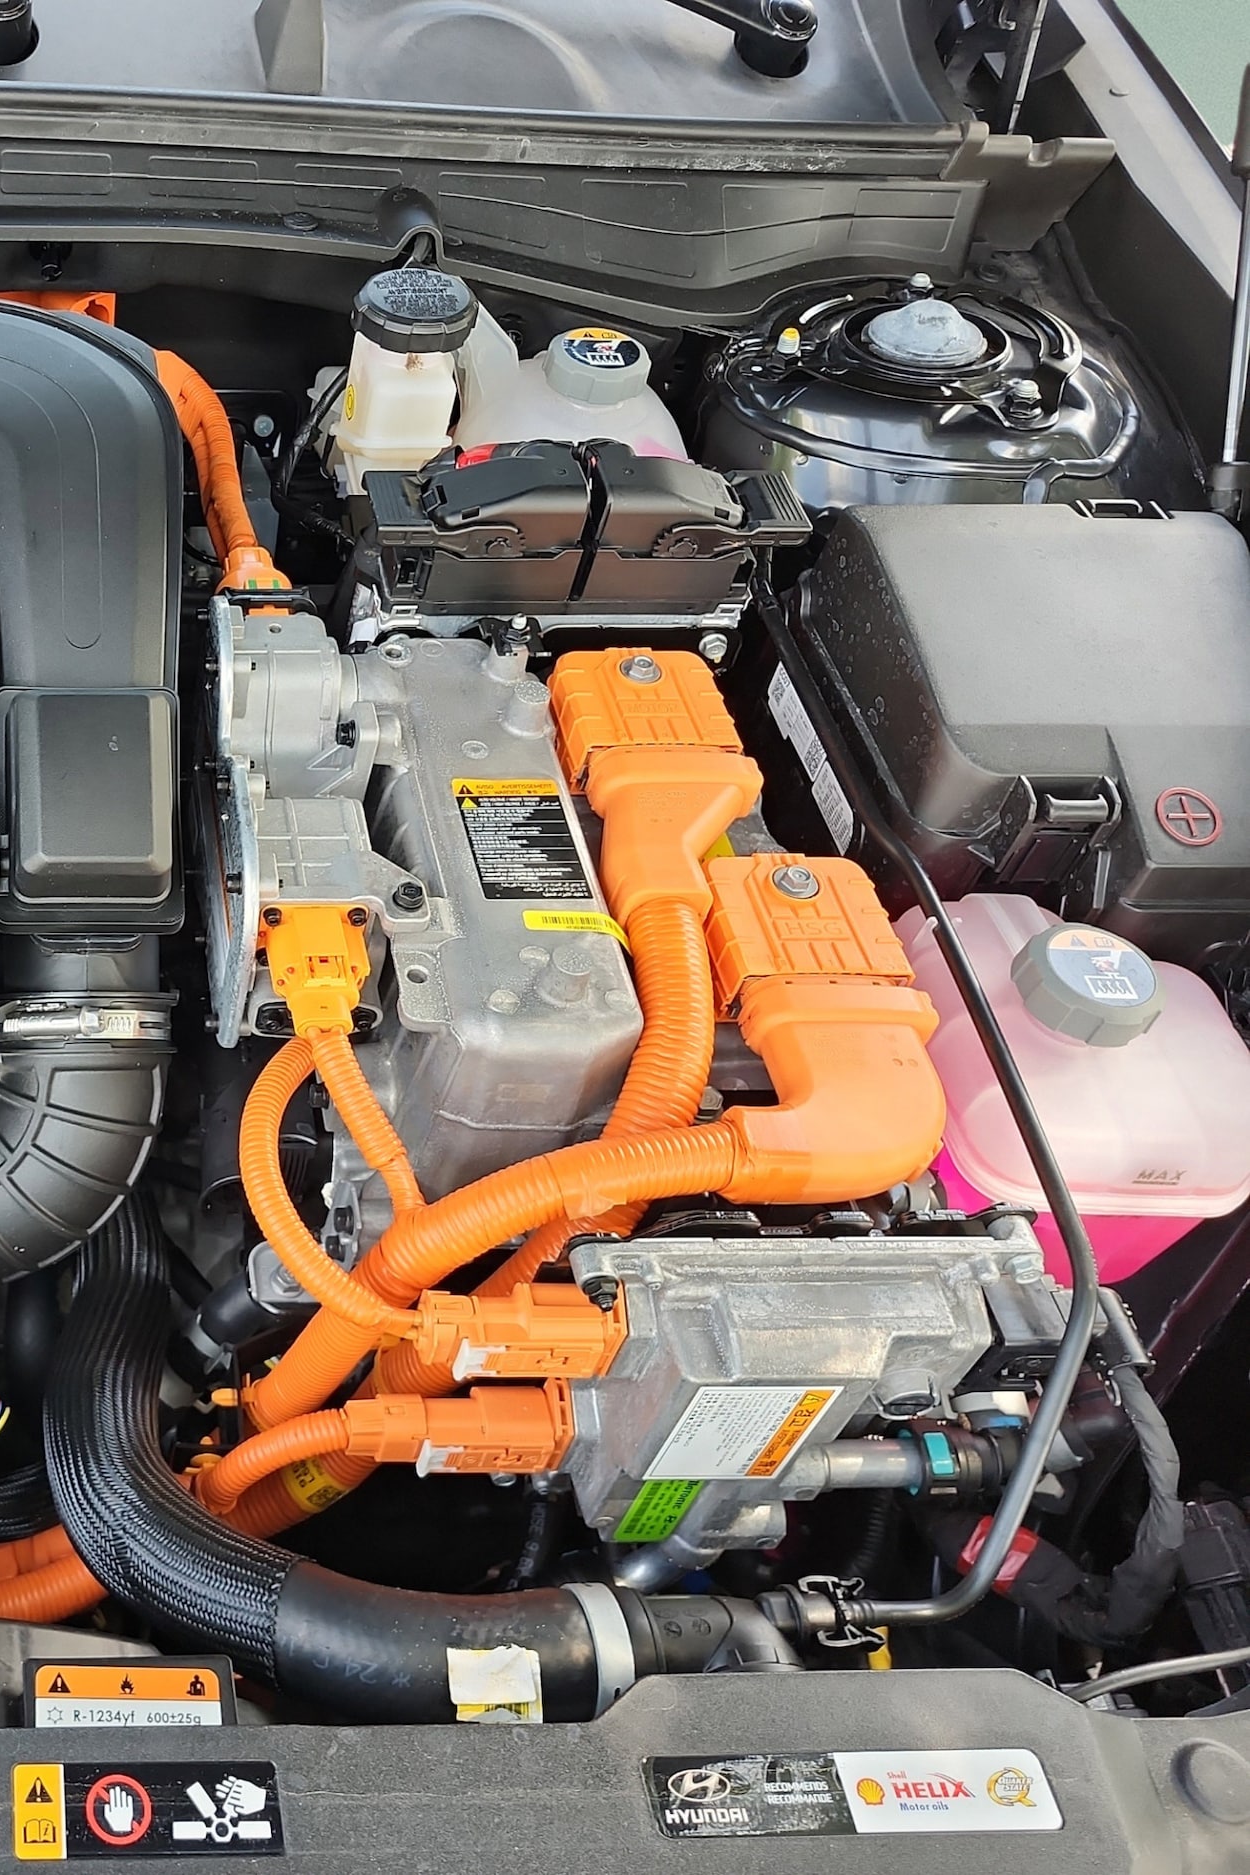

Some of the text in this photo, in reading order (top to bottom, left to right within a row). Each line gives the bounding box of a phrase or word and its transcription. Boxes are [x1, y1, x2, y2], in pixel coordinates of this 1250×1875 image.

[784, 921, 844, 935] HSG
[1136, 1168, 1187, 1182] MAX
[72, 1709, 136, 1727] R-1234yf
[886, 1770, 907, 1780] Shell
[764, 1780, 829, 1793] RECOMMENDS
[892, 1781, 971, 1799] HELIX
[768, 1792, 834, 1805] RECOMMANDE
[900, 1801, 949, 1811] Motor oils
[665, 1807, 750, 1825] HYUNDAI
